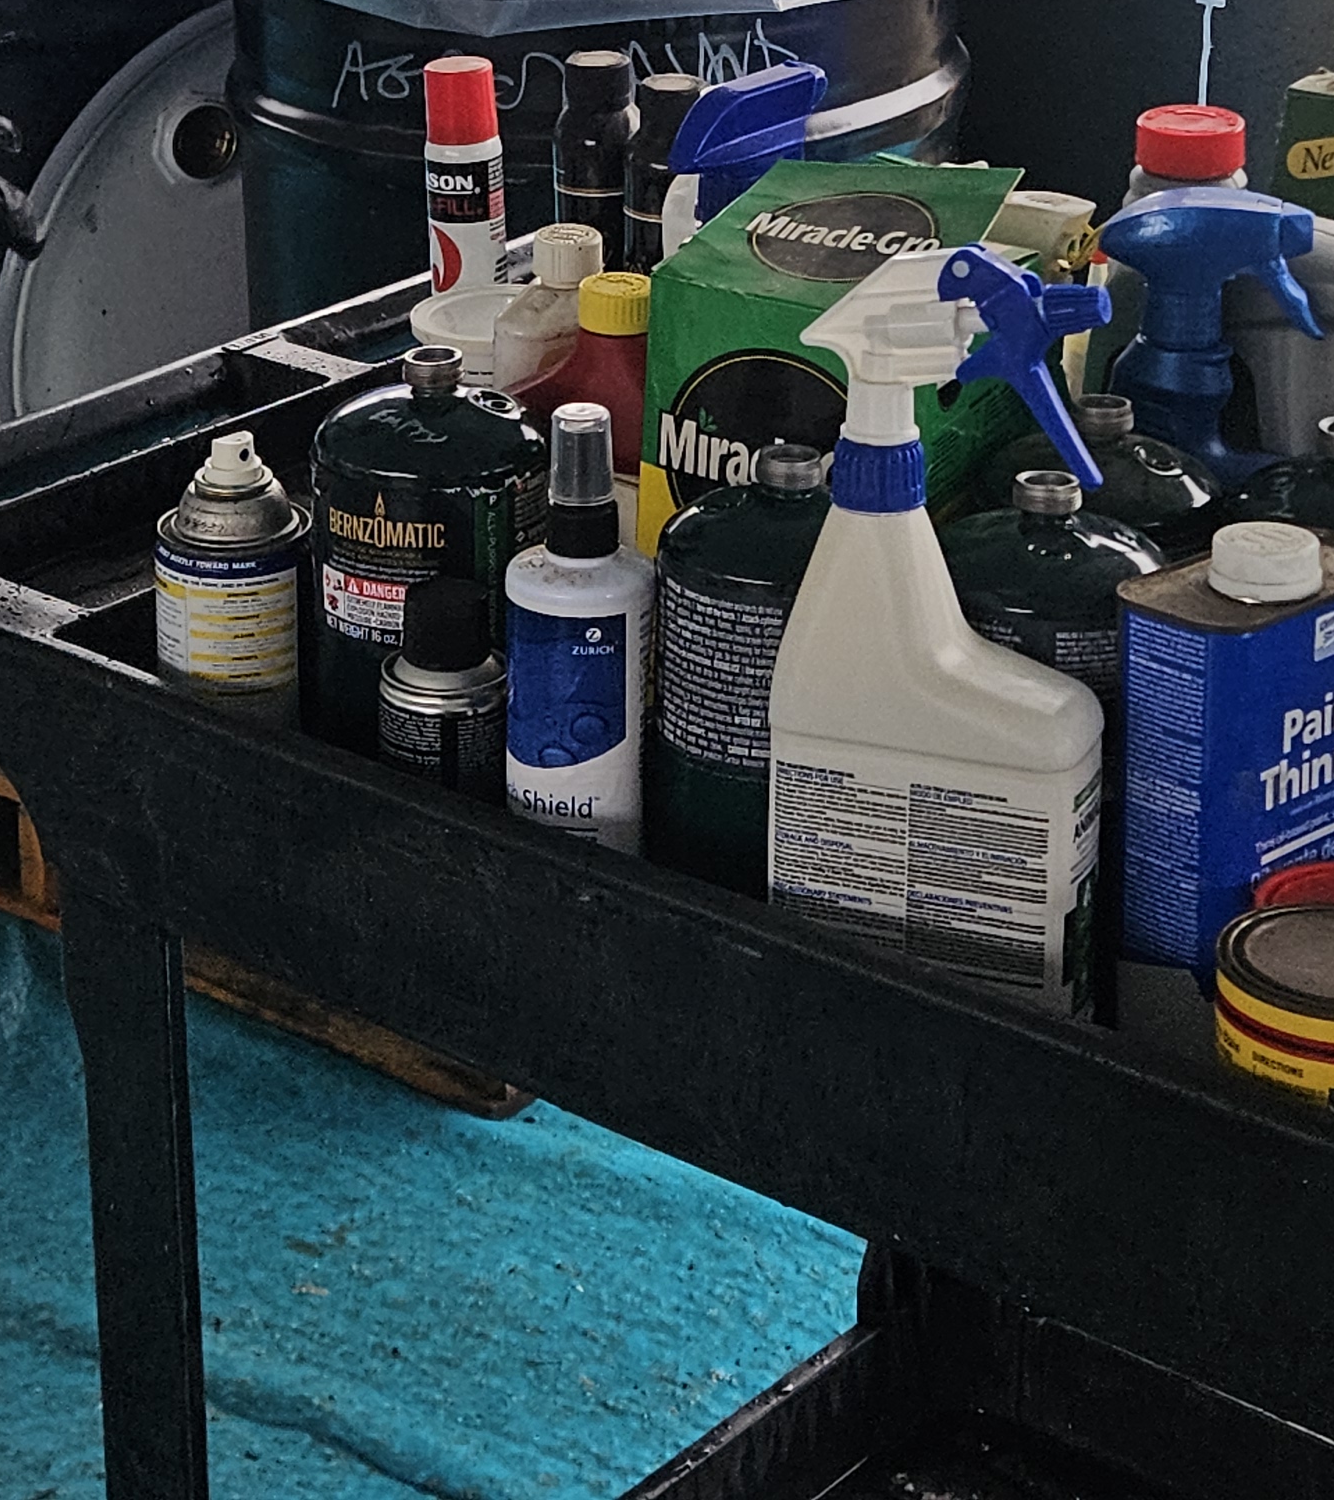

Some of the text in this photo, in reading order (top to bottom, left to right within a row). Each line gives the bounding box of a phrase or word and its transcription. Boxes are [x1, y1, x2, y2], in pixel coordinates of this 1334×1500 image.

[329, 506, 445, 549] BERNZOMATIC
[362, 581, 406, 600] DANGER
[571, 645, 615, 656] ZURICH
[522, 787, 593, 820] Shield
